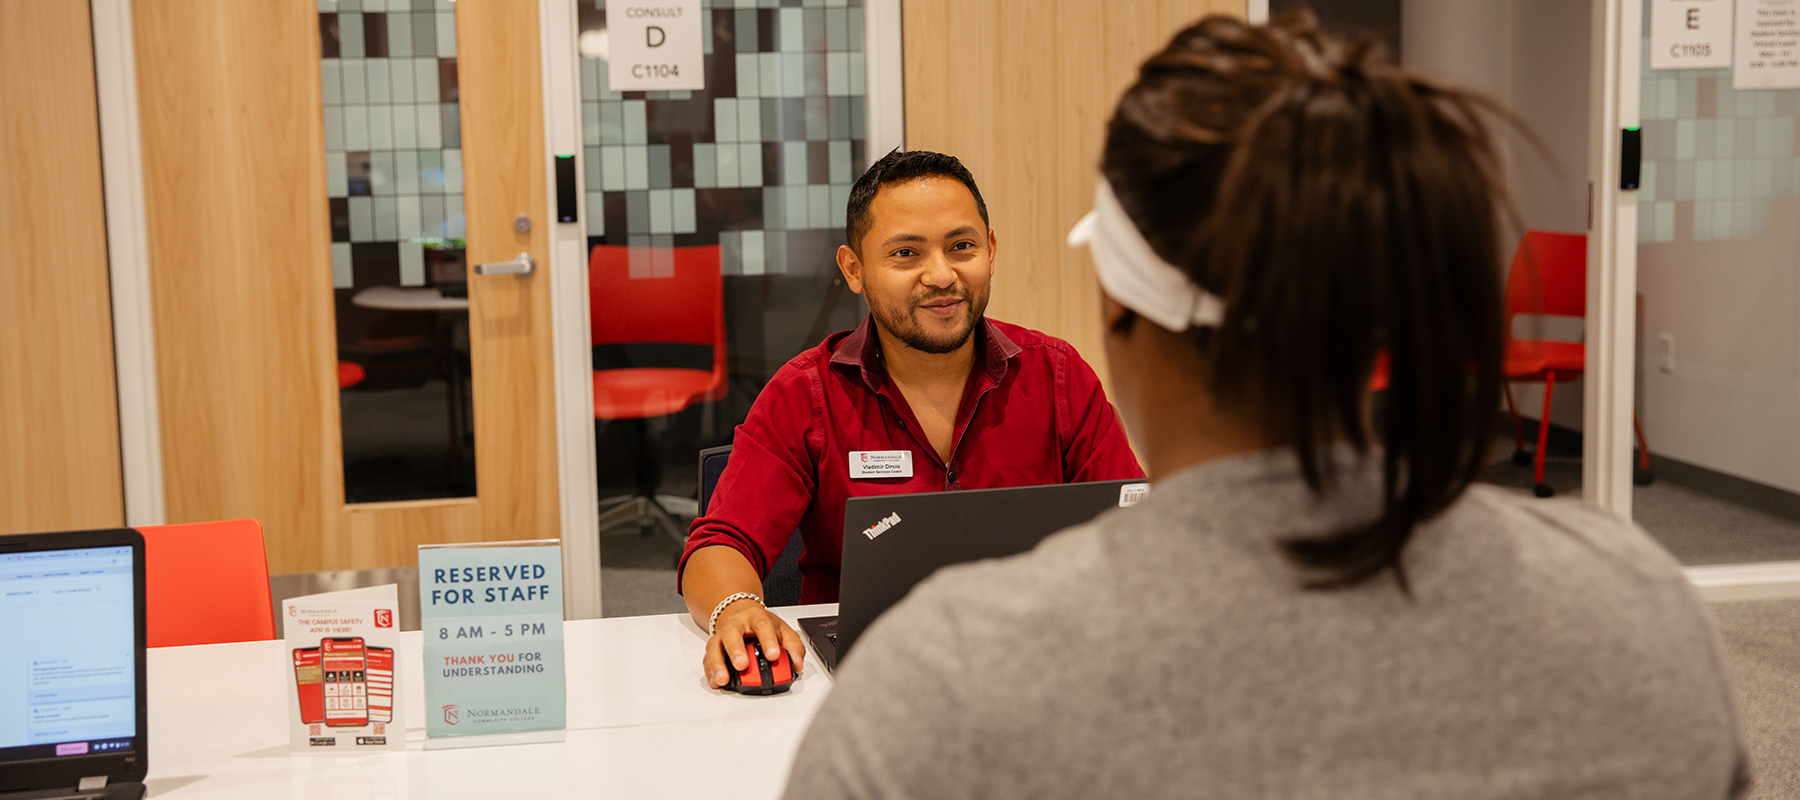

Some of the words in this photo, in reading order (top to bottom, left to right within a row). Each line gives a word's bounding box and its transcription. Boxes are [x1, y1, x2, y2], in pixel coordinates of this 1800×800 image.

[625, 6, 683, 19] CONSULT
[1686, 7, 1701, 30] E
[646, 25, 666, 48] D
[631, 63, 680, 79] C1104
[862, 511, 902, 540] ThinkPad
[434, 564, 546, 584] RESERVED
[432, 589, 475, 605] FOR
[484, 585, 549, 603] STAFF
[439, 627, 449, 640] 8
[456, 626, 483, 639] AM
[504, 624, 513, 637] 5
[521, 623, 546, 636] PM
[444, 655, 485, 666] THANK
[489, 654, 515, 664] YOU
[518, 652, 542, 662] FOR
[443, 664, 544, 678] UNDERSTANDING
[467, 707, 540, 718] NORMANDALE
